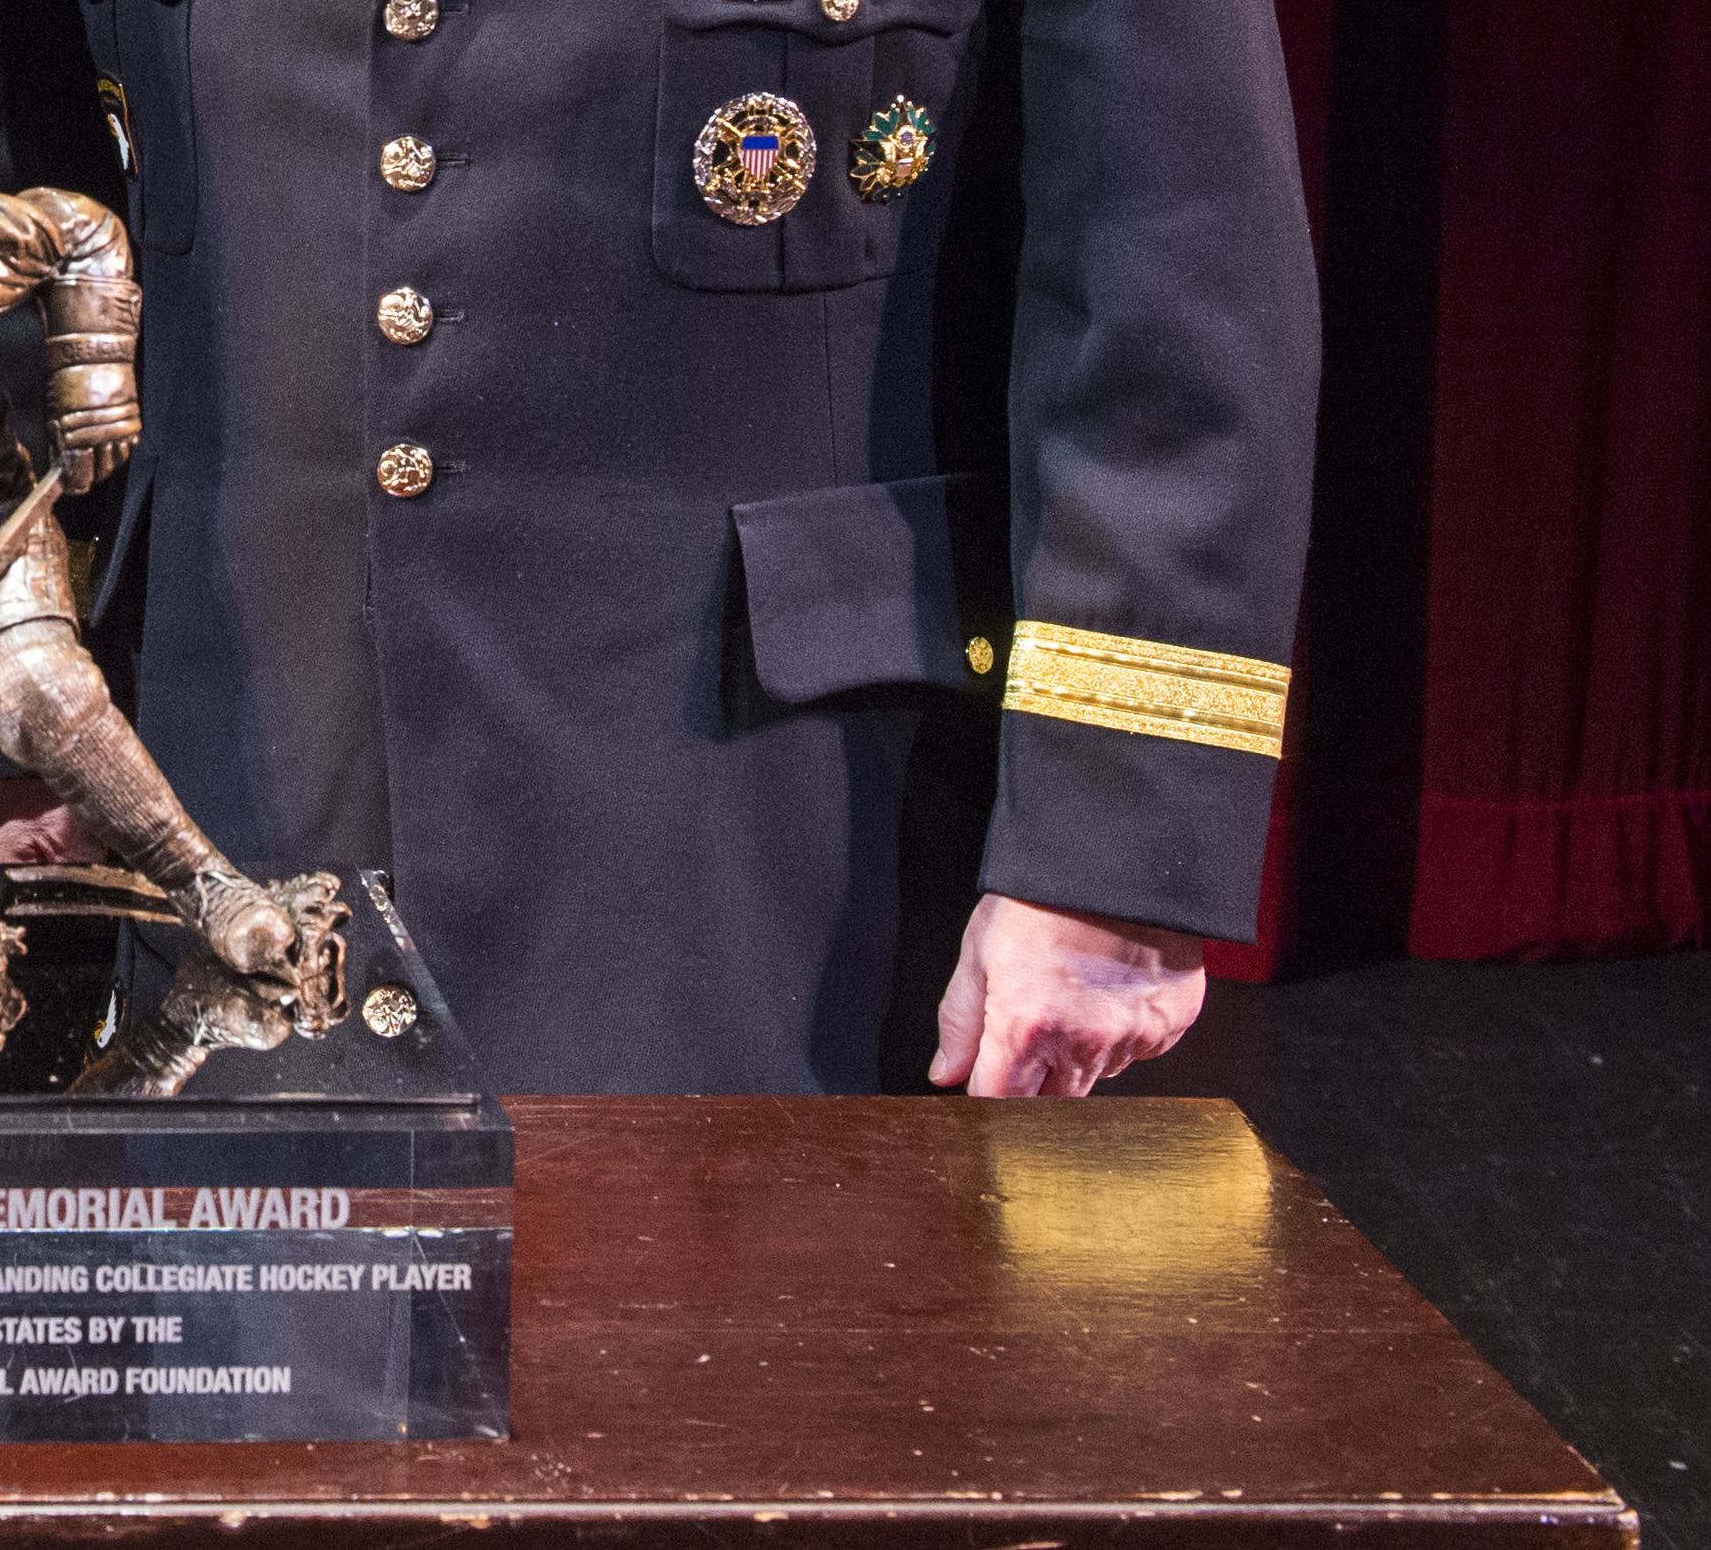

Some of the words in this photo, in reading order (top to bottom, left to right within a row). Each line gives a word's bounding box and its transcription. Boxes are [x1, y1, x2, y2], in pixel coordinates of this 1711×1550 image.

[188, 1187, 350, 1230] AWARD
[95, 1264, 253, 1293] COLLEGIATE
[259, 1263, 366, 1292] HOCKEY
[371, 1262, 473, 1291] PLAYER
[88, 1316, 126, 1344] BY
[131, 1315, 184, 1344] THE
[19, 1367, 119, 1396] AWARD
[124, 1366, 291, 1395] FOUNDATION
